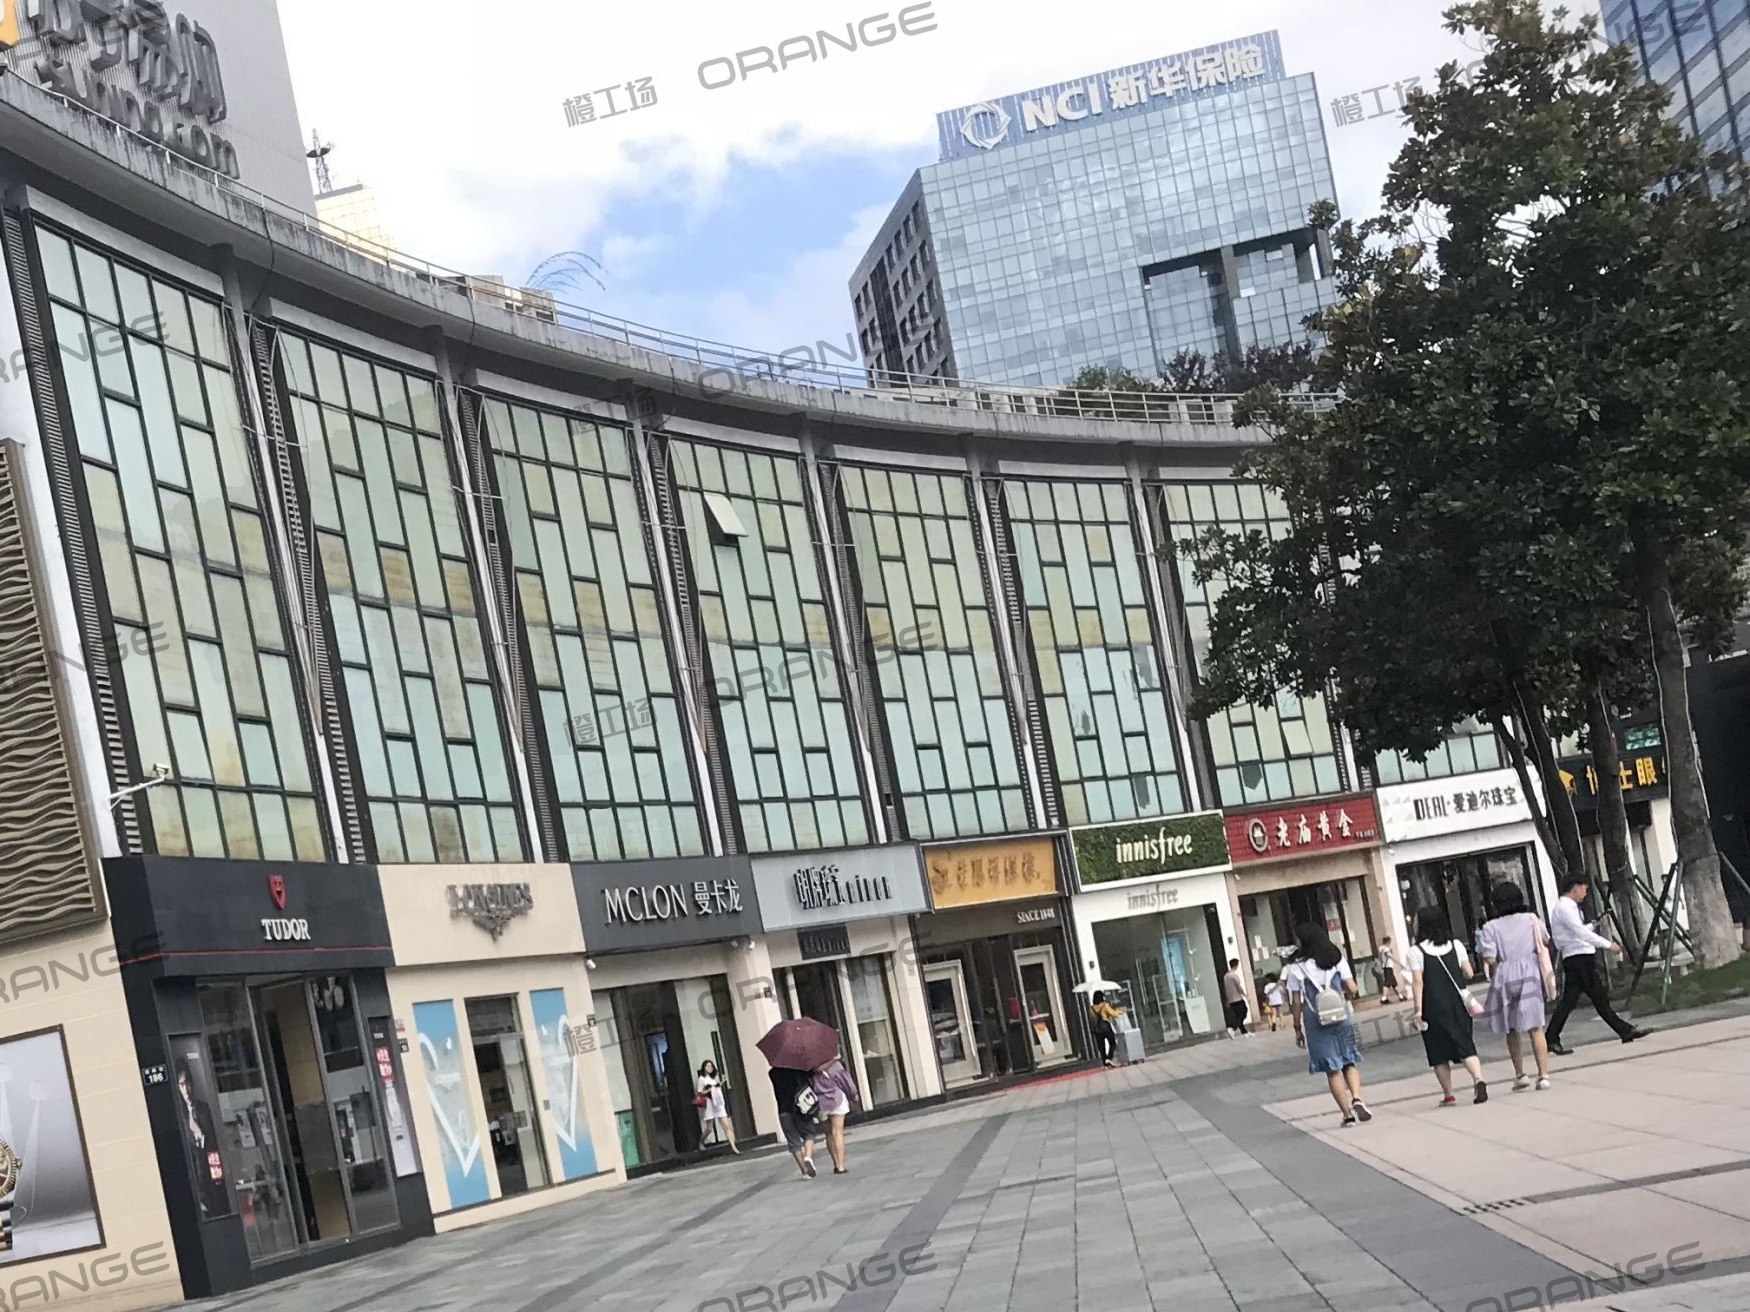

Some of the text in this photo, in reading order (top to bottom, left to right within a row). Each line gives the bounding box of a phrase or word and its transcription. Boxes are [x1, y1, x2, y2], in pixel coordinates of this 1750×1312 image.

[1022, 44, 1265, 131] NCI 新华保险
[1116, 827, 1192, 864] innisfree
[604, 879, 743, 923] MCLON 曼卡龙
[1127, 884, 1178, 911] innisfree
[261, 918, 311, 940] TUDOR
